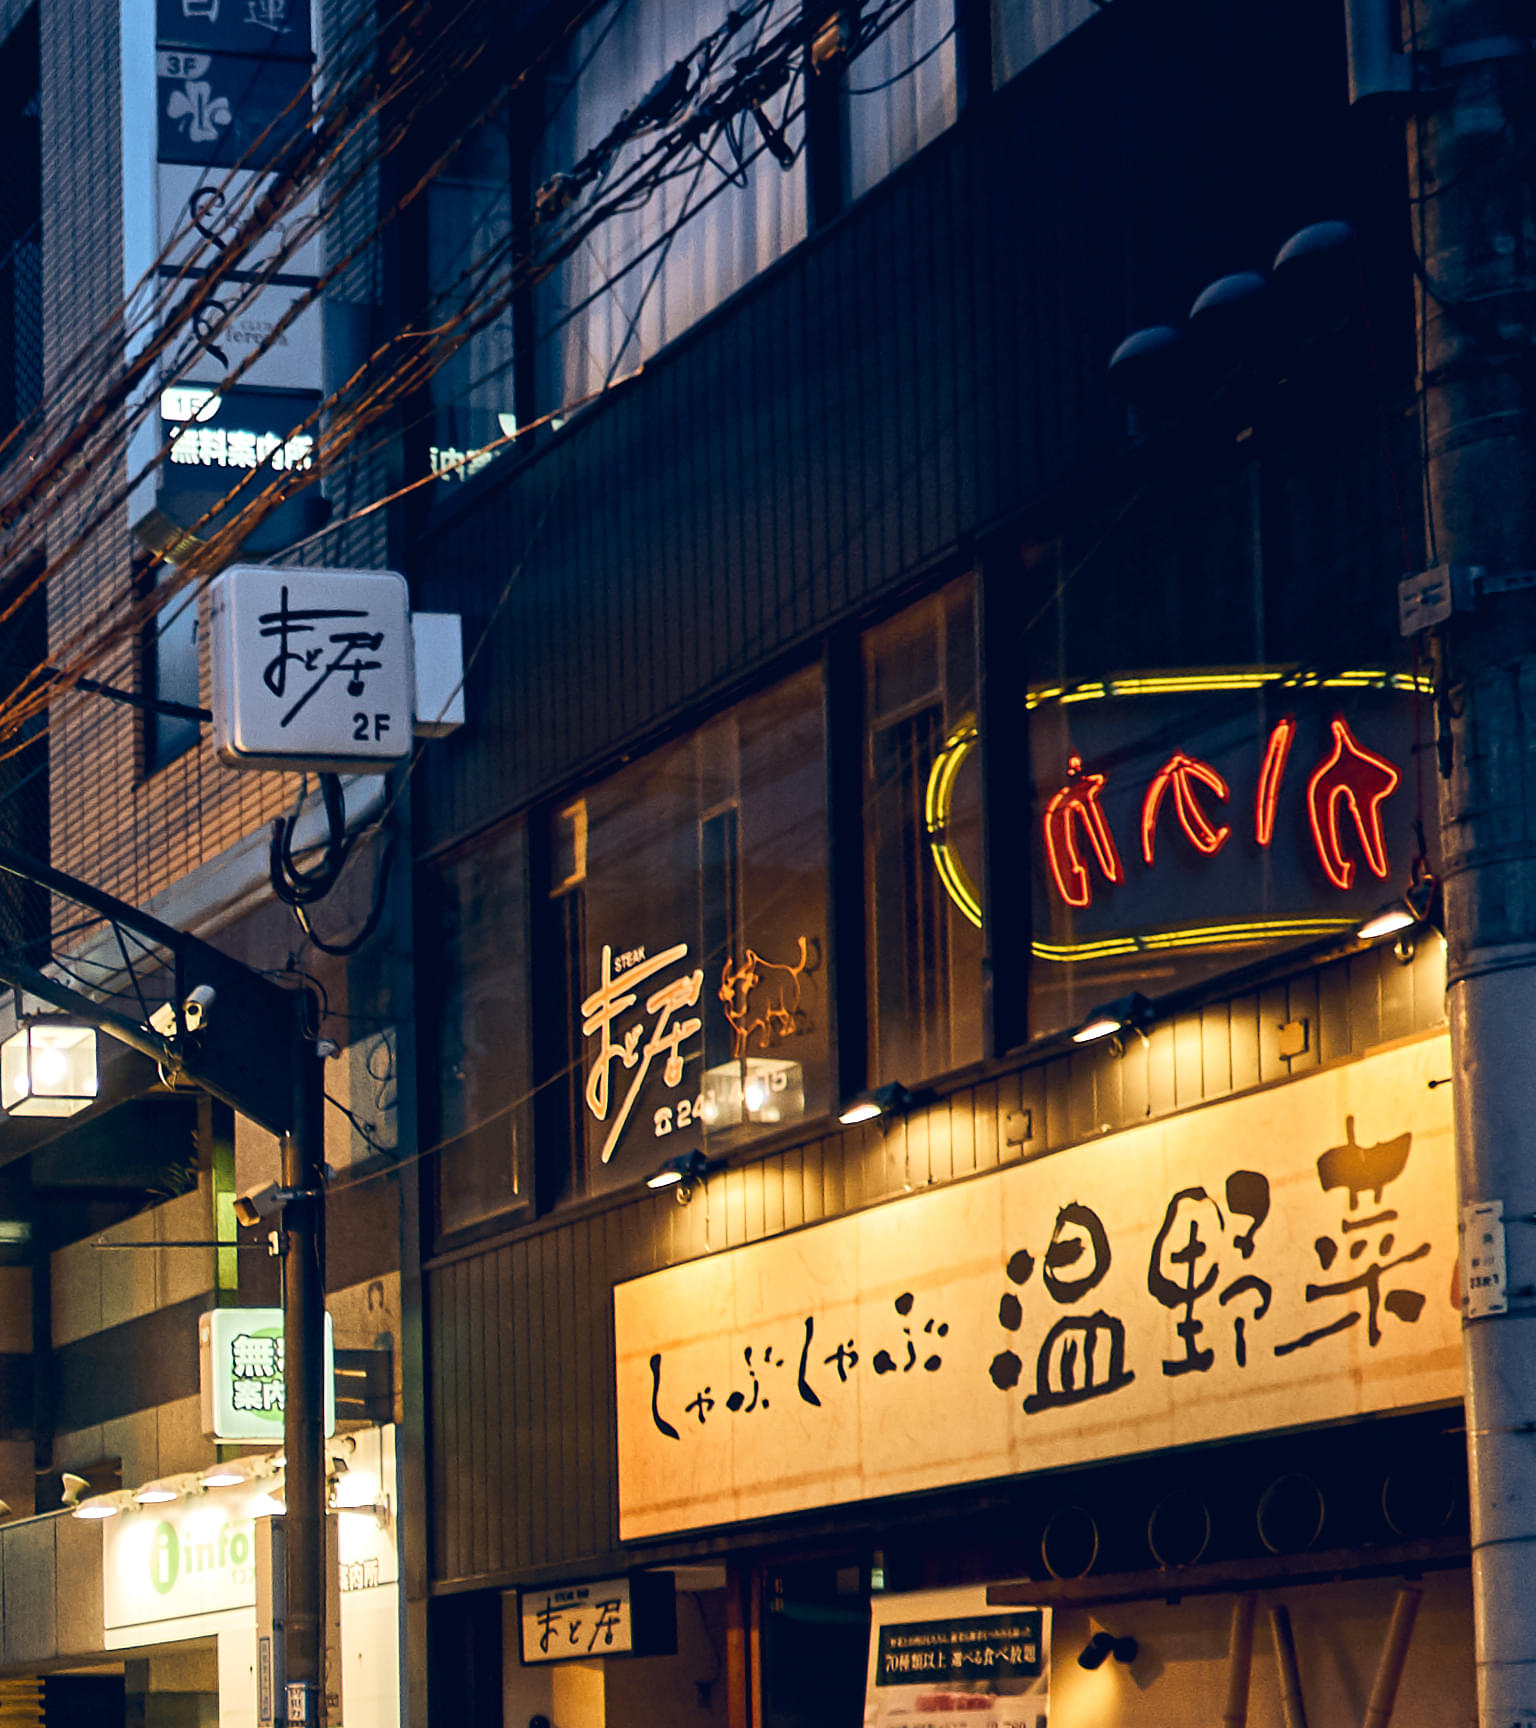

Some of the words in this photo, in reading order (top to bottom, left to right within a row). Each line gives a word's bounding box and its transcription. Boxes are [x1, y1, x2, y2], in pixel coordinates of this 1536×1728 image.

[167, 56, 197, 75] 3F
[169, 427, 314, 470] 無料案内所
[353, 712, 391, 741] 2F
[614, 945, 647, 974] STEAK
[989, 1114, 1433, 1414] 温野菜
[649, 1291, 951, 1441] しゃぶしゃぶ
[232, 1379, 285, 1411] 案内
